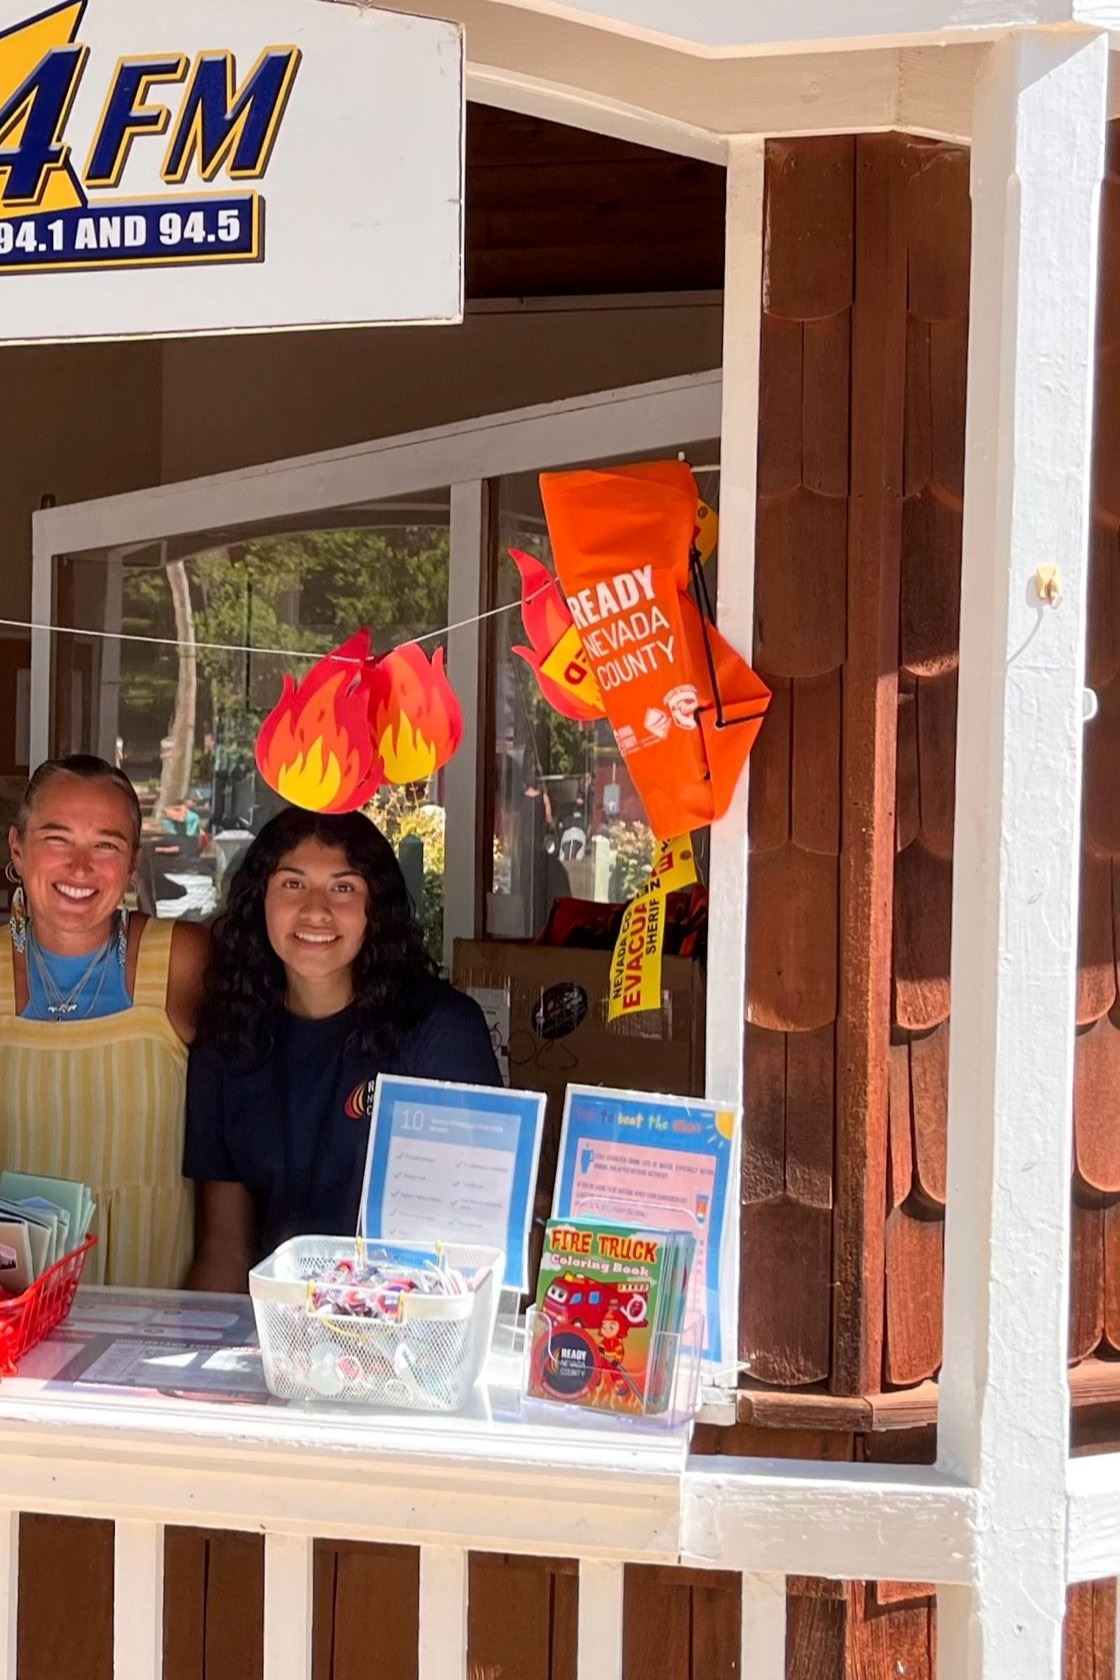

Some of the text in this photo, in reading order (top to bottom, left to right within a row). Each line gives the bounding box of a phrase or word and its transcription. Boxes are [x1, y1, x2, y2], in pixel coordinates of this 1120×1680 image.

[83, 44, 301, 188] FM
[74, 215, 147, 250] AND
[158, 209, 241, 244] 94.5
[566, 564, 656, 631] READY
[582, 605, 671, 661] NEVADA
[597, 634, 674, 692] COUNTY
[613, 936, 628, 1000] NEVADA
[400, 1109, 424, 1131] 10
[618, 1112, 643, 1129] beat
[647, 1114, 669, 1131] the
[549, 1228, 660, 1264] FIRE TRUCK
[550, 1253, 650, 1277] Coloring Book
[561, 1348, 587, 1361] READY
